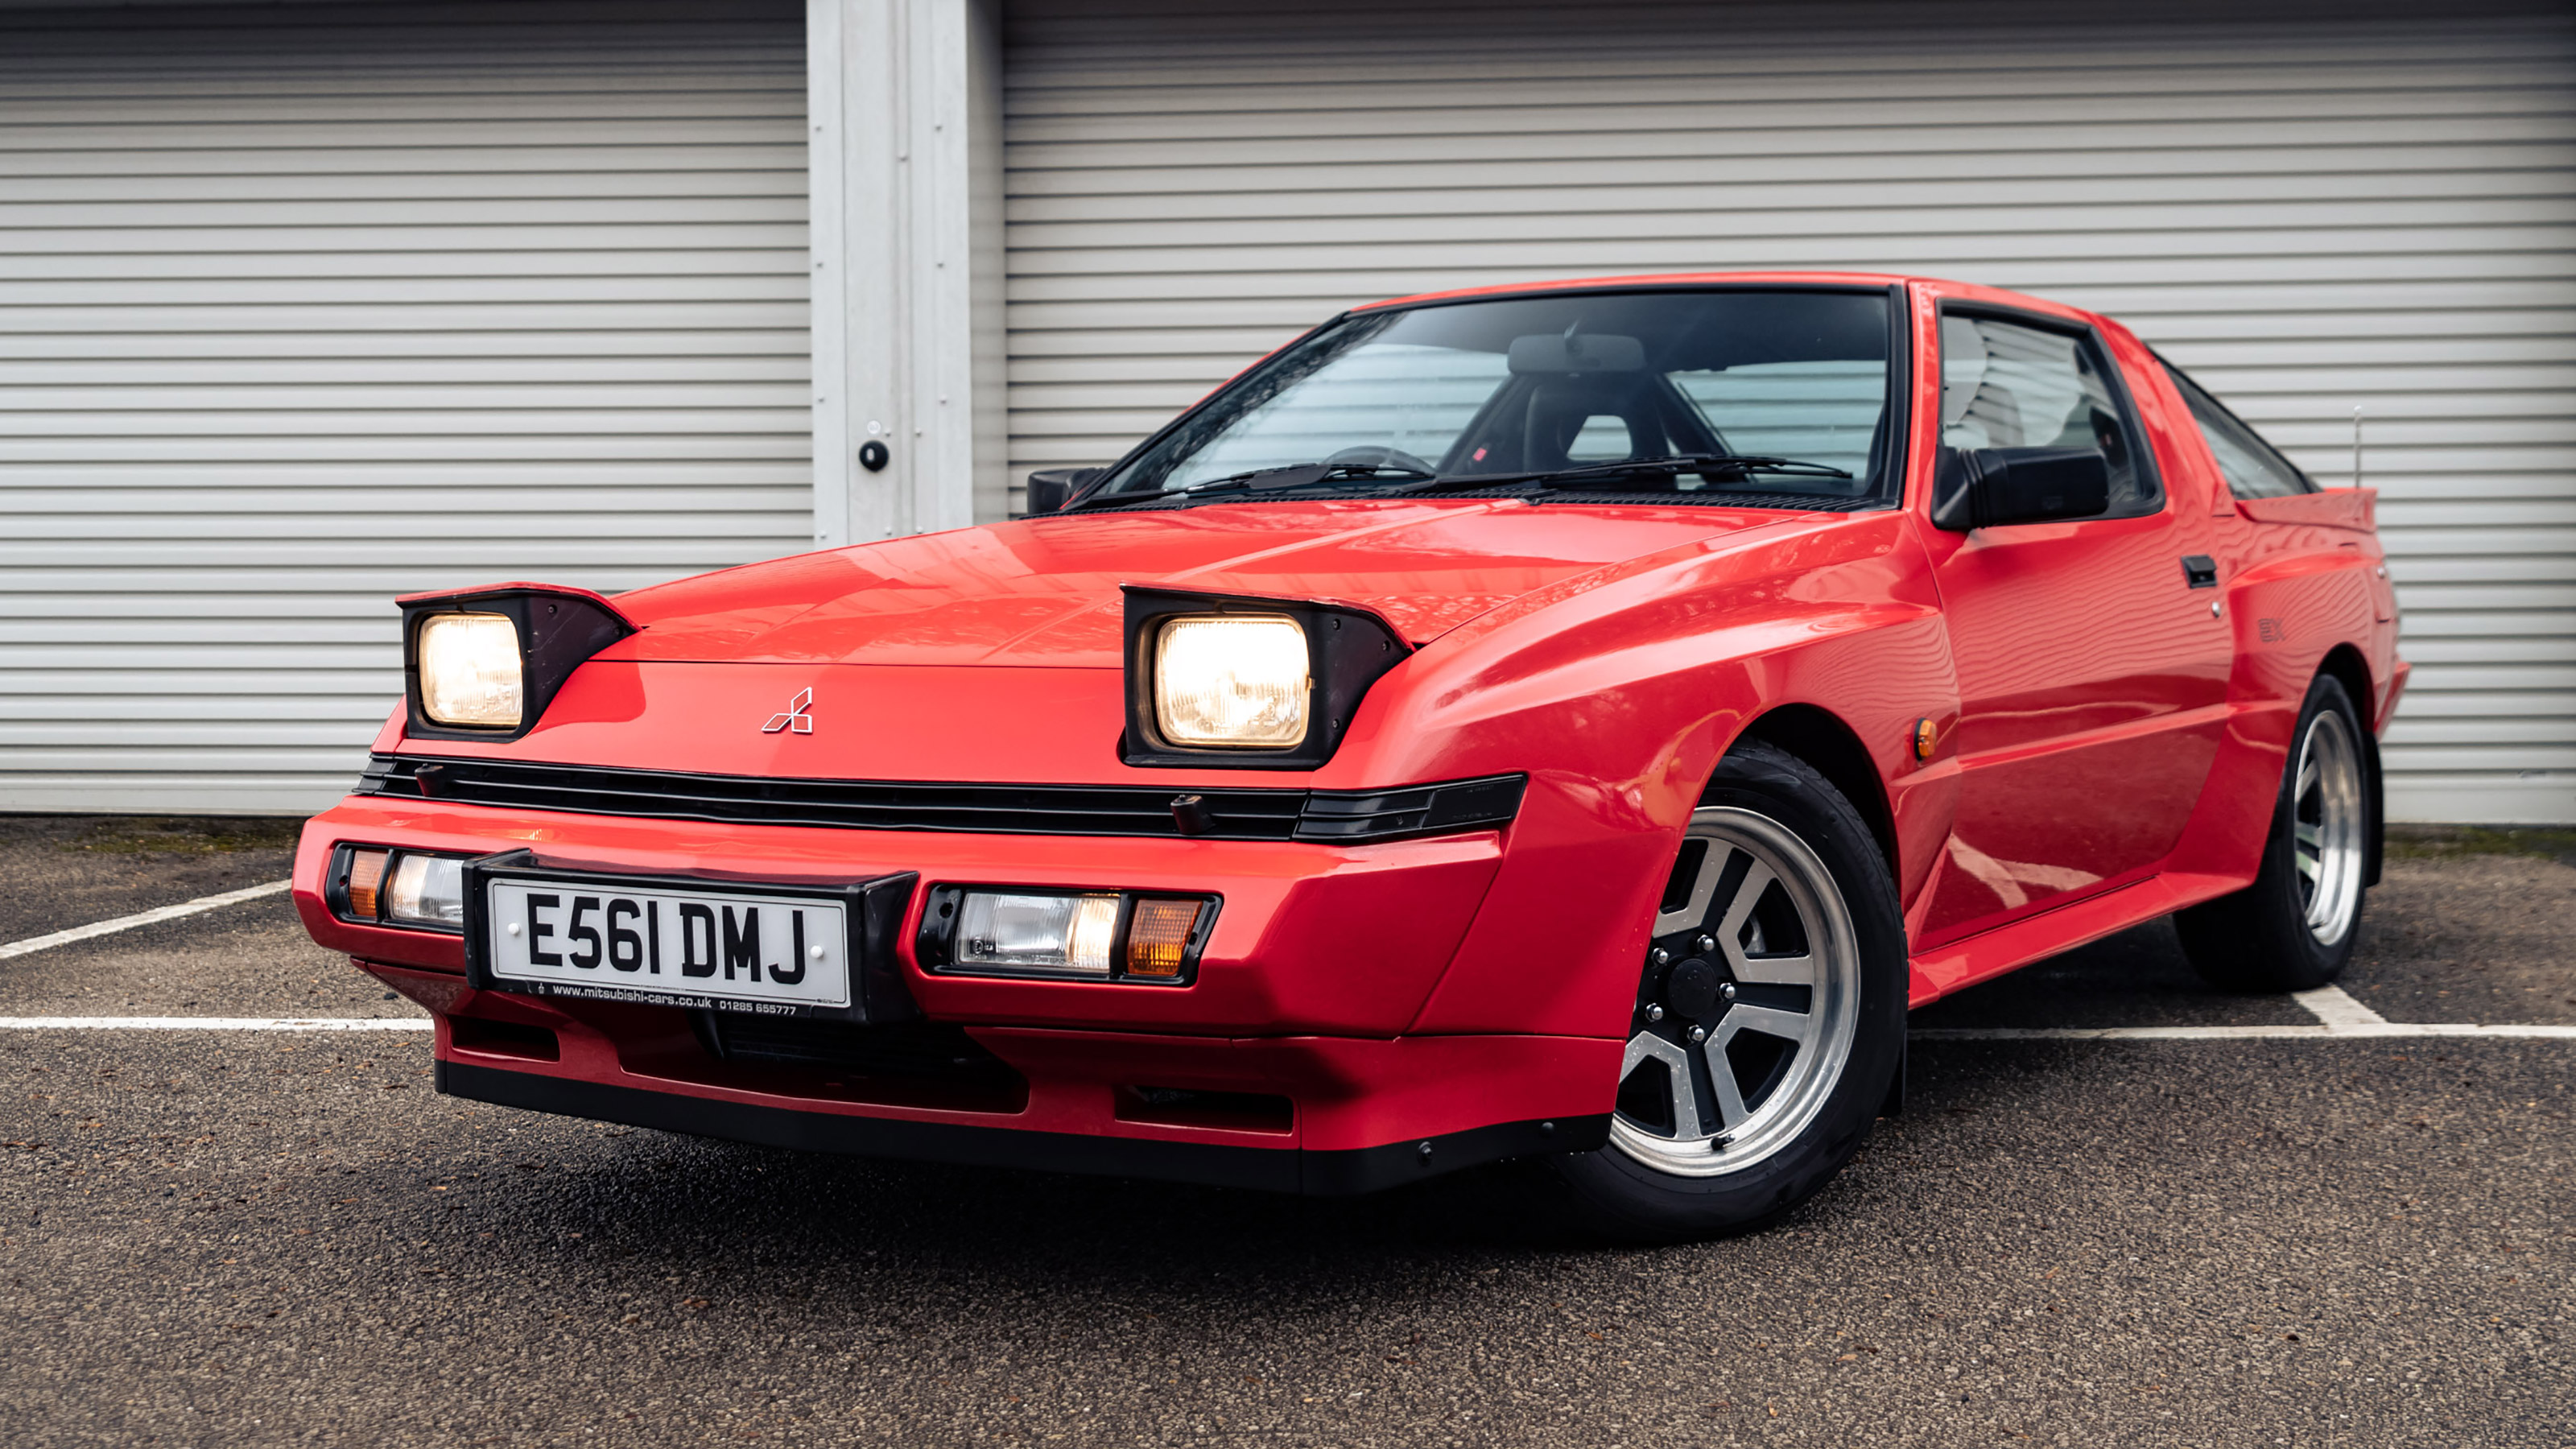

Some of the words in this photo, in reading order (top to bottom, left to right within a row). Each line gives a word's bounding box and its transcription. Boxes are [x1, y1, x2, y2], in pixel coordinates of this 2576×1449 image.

[527, 894, 660, 974] E561
[679, 902, 806, 985] DMJ
[553, 985, 712, 1008] www.mitsubishi-cars.co.uk
[720, 1001, 753, 1012] 01285
[755, 1003, 797, 1015] 655777
